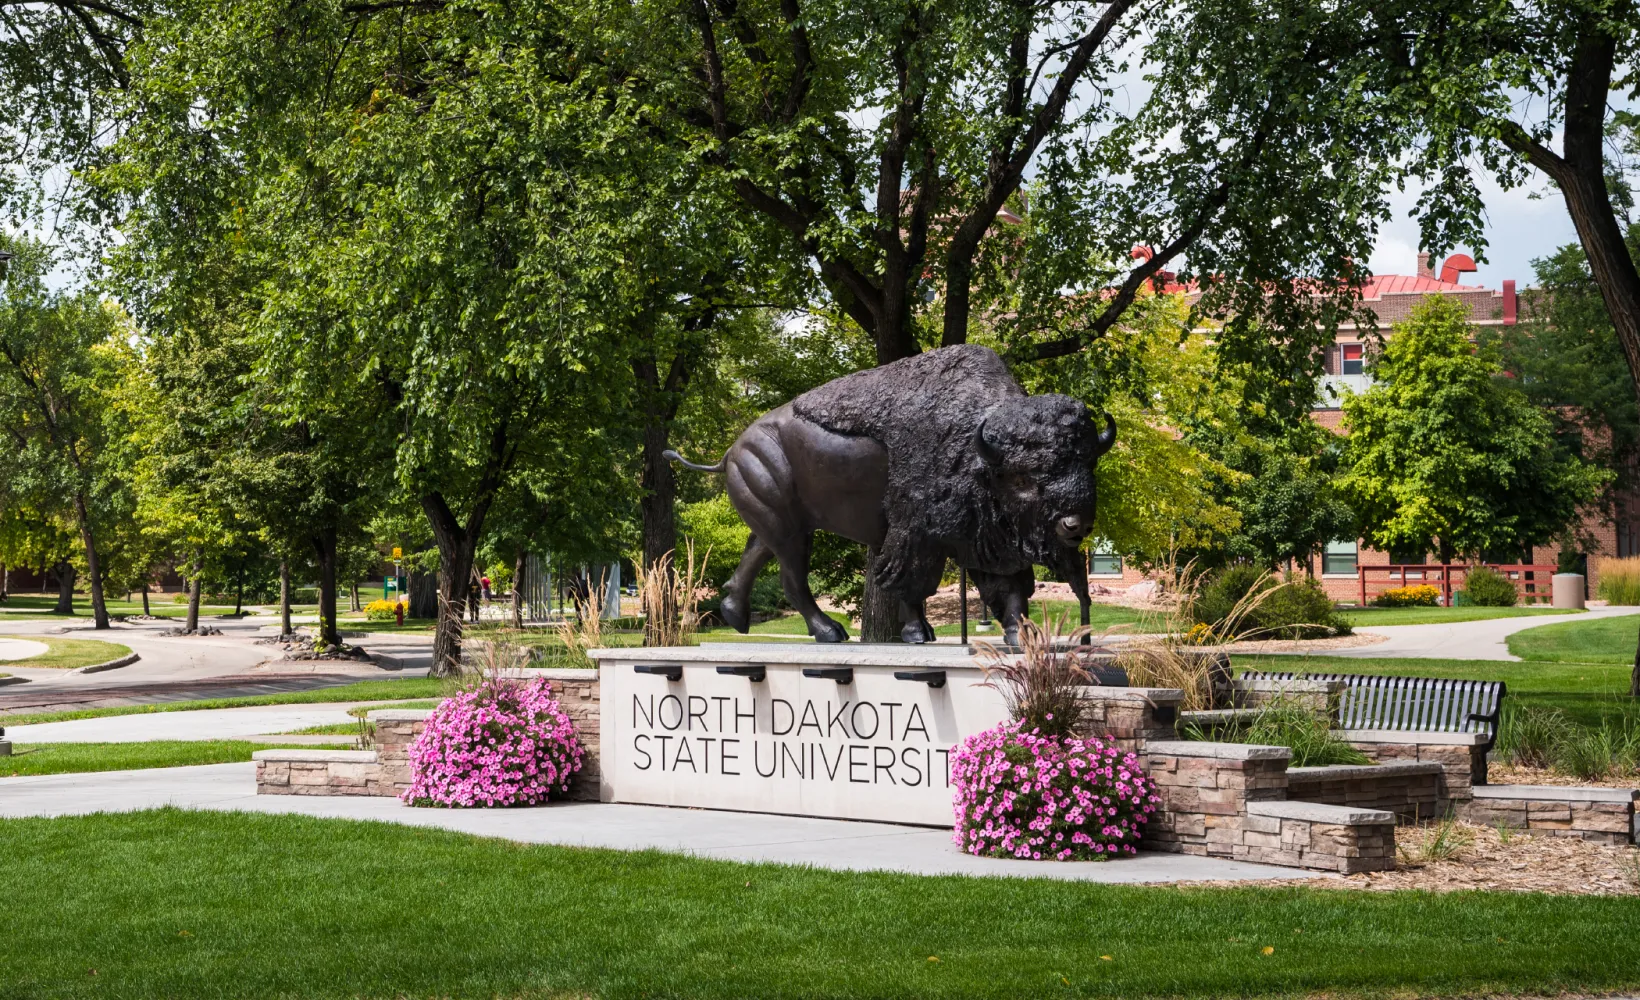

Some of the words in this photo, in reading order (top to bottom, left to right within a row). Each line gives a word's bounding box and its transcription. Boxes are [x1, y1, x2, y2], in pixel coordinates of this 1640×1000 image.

[633, 693, 756, 735] NORTH
[771, 698, 931, 743] DAKOTA
[633, 734, 741, 776] STATE
[754, 740, 951, 789] UNIVERSIT
